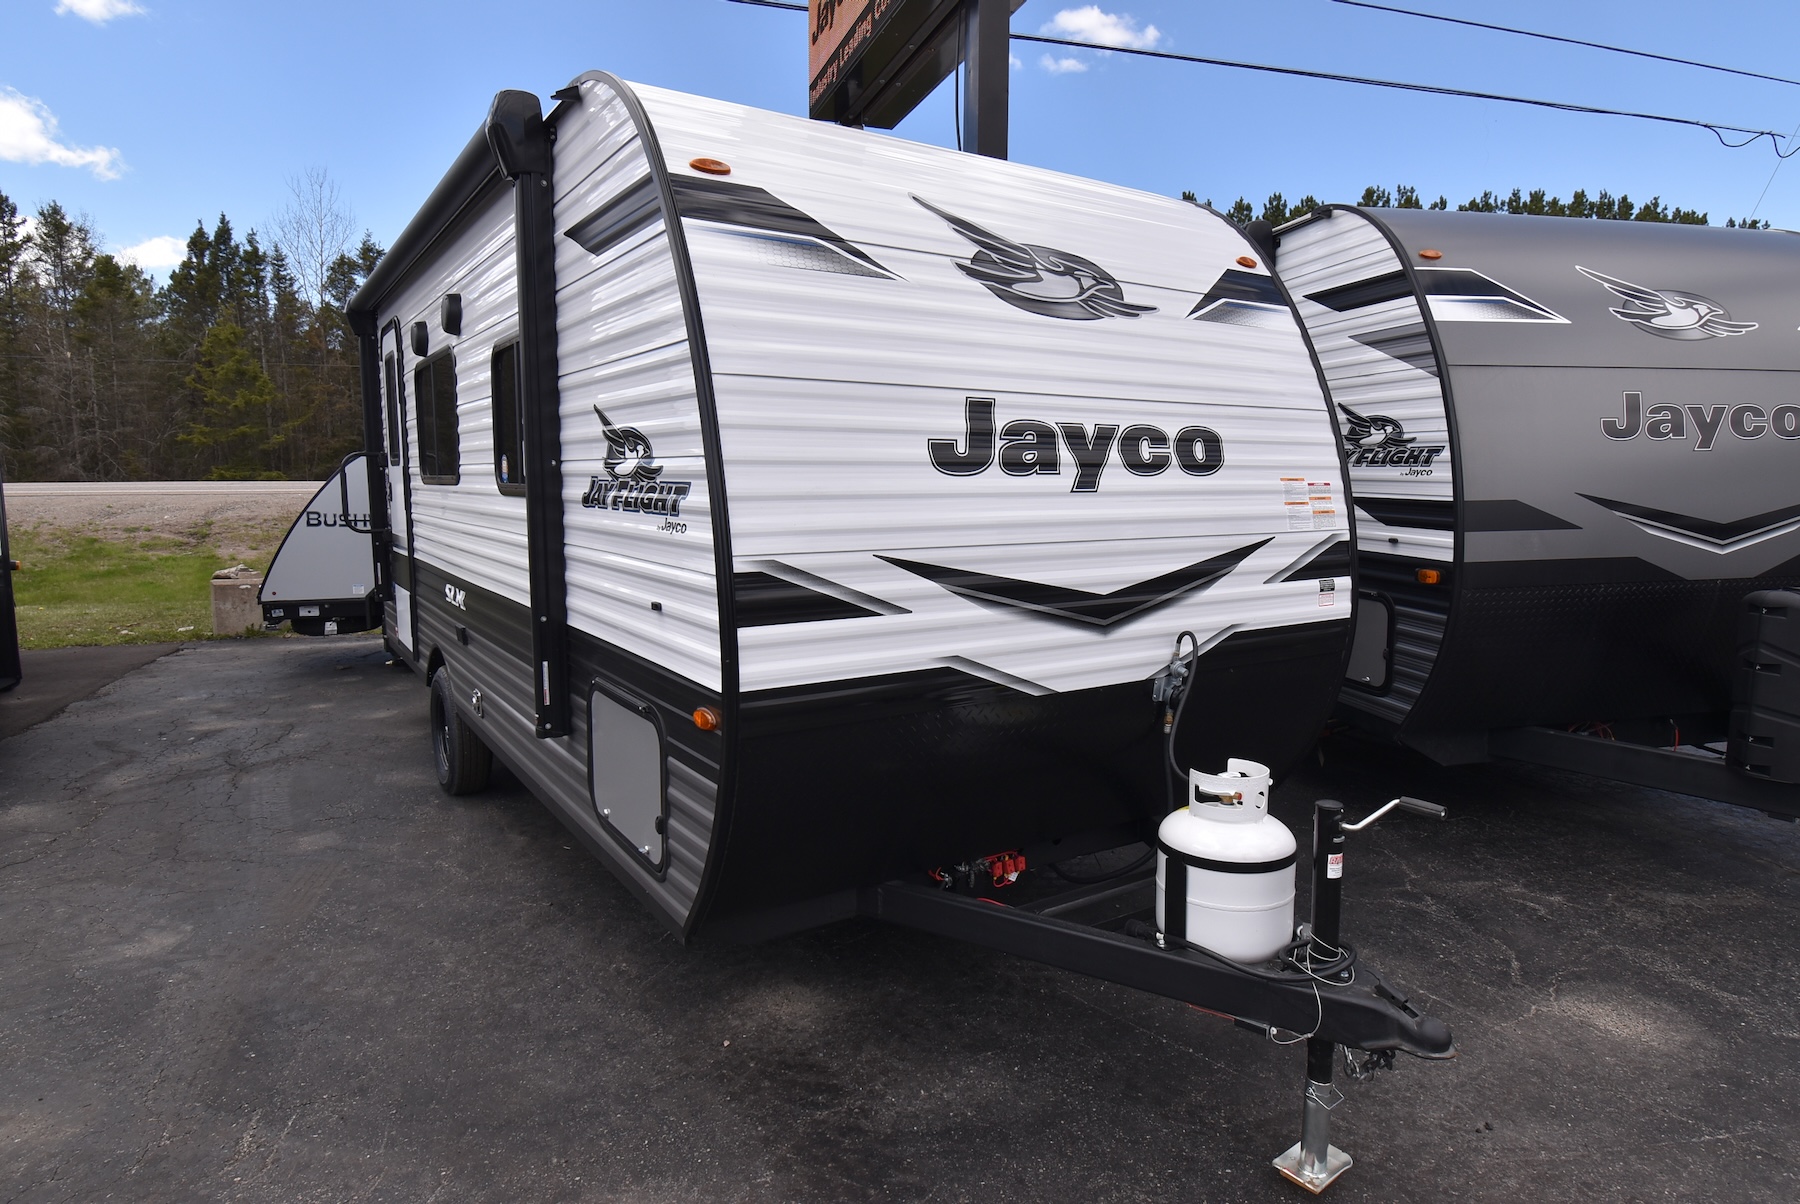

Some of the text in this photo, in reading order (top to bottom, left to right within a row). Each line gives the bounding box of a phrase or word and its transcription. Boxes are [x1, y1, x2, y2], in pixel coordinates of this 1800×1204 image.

[1600, 390, 1800, 451] Jayco
[927, 396, 1225, 493] Jayco
[1352, 445, 1446, 468] FLIGHT
[1405, 467, 1433, 478] Jayco
[306, 511, 371, 528] BUSH
[661, 518, 687, 535] Jayco
